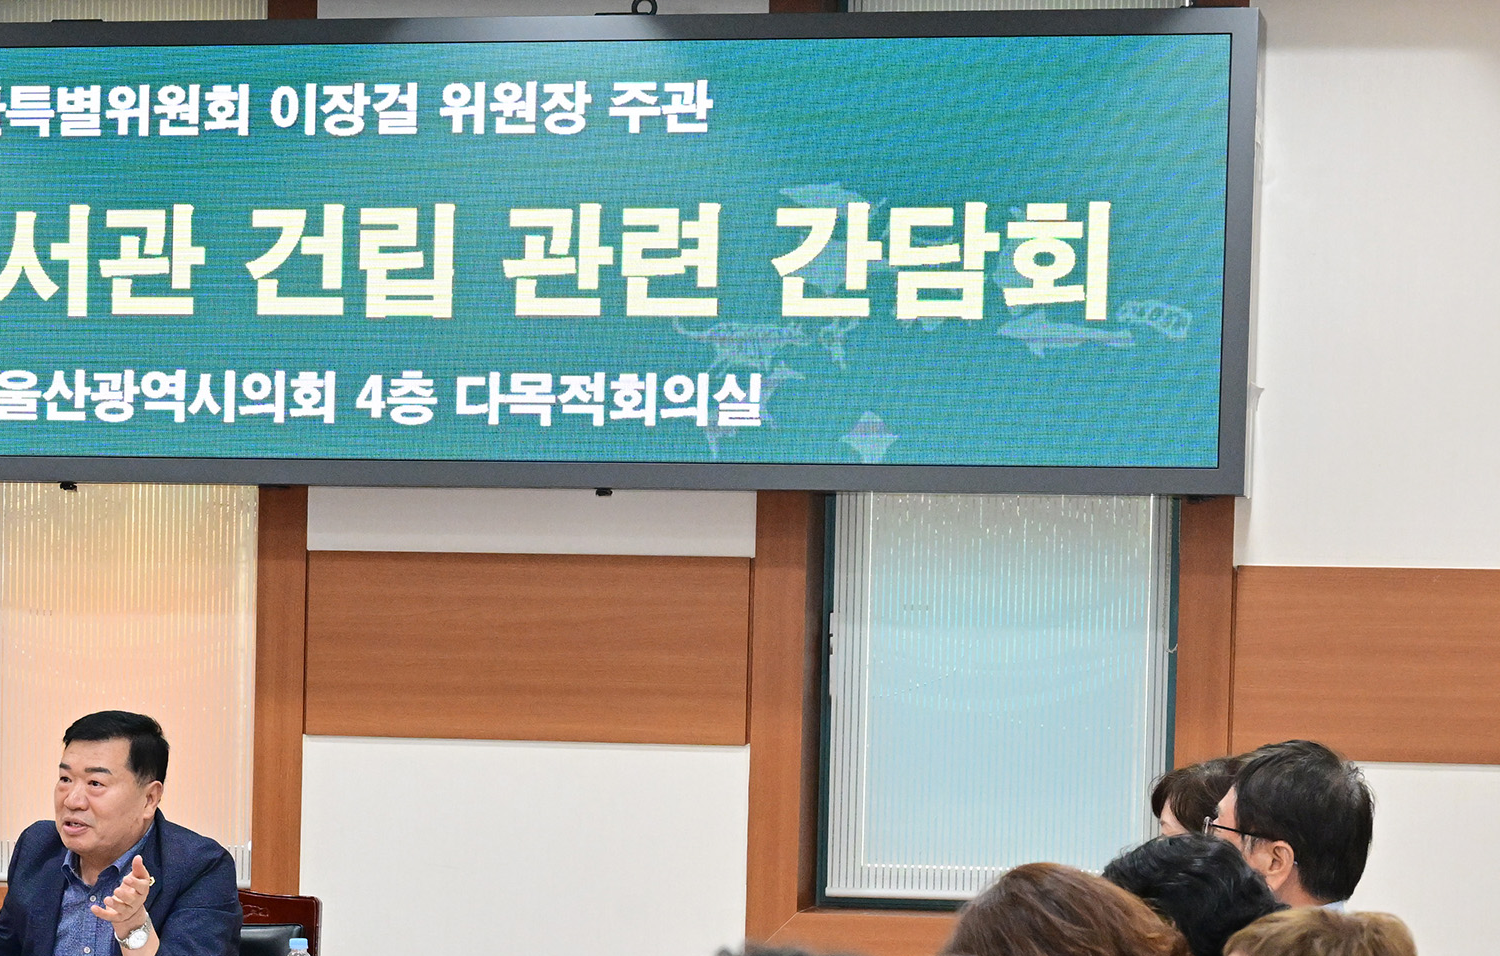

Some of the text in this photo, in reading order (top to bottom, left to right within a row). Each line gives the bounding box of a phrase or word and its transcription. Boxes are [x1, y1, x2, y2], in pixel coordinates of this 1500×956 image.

[270, 82, 420, 139] 이장걸
[439, 80, 596, 137] 위원장
[608, 79, 716, 136] 주관
[246, 203, 458, 320] 건립
[503, 202, 723, 319] 관련
[772, 201, 1113, 322] 간담회
[355, 370, 440, 428] 4층
[456, 371, 764, 429] 다목적회의실
